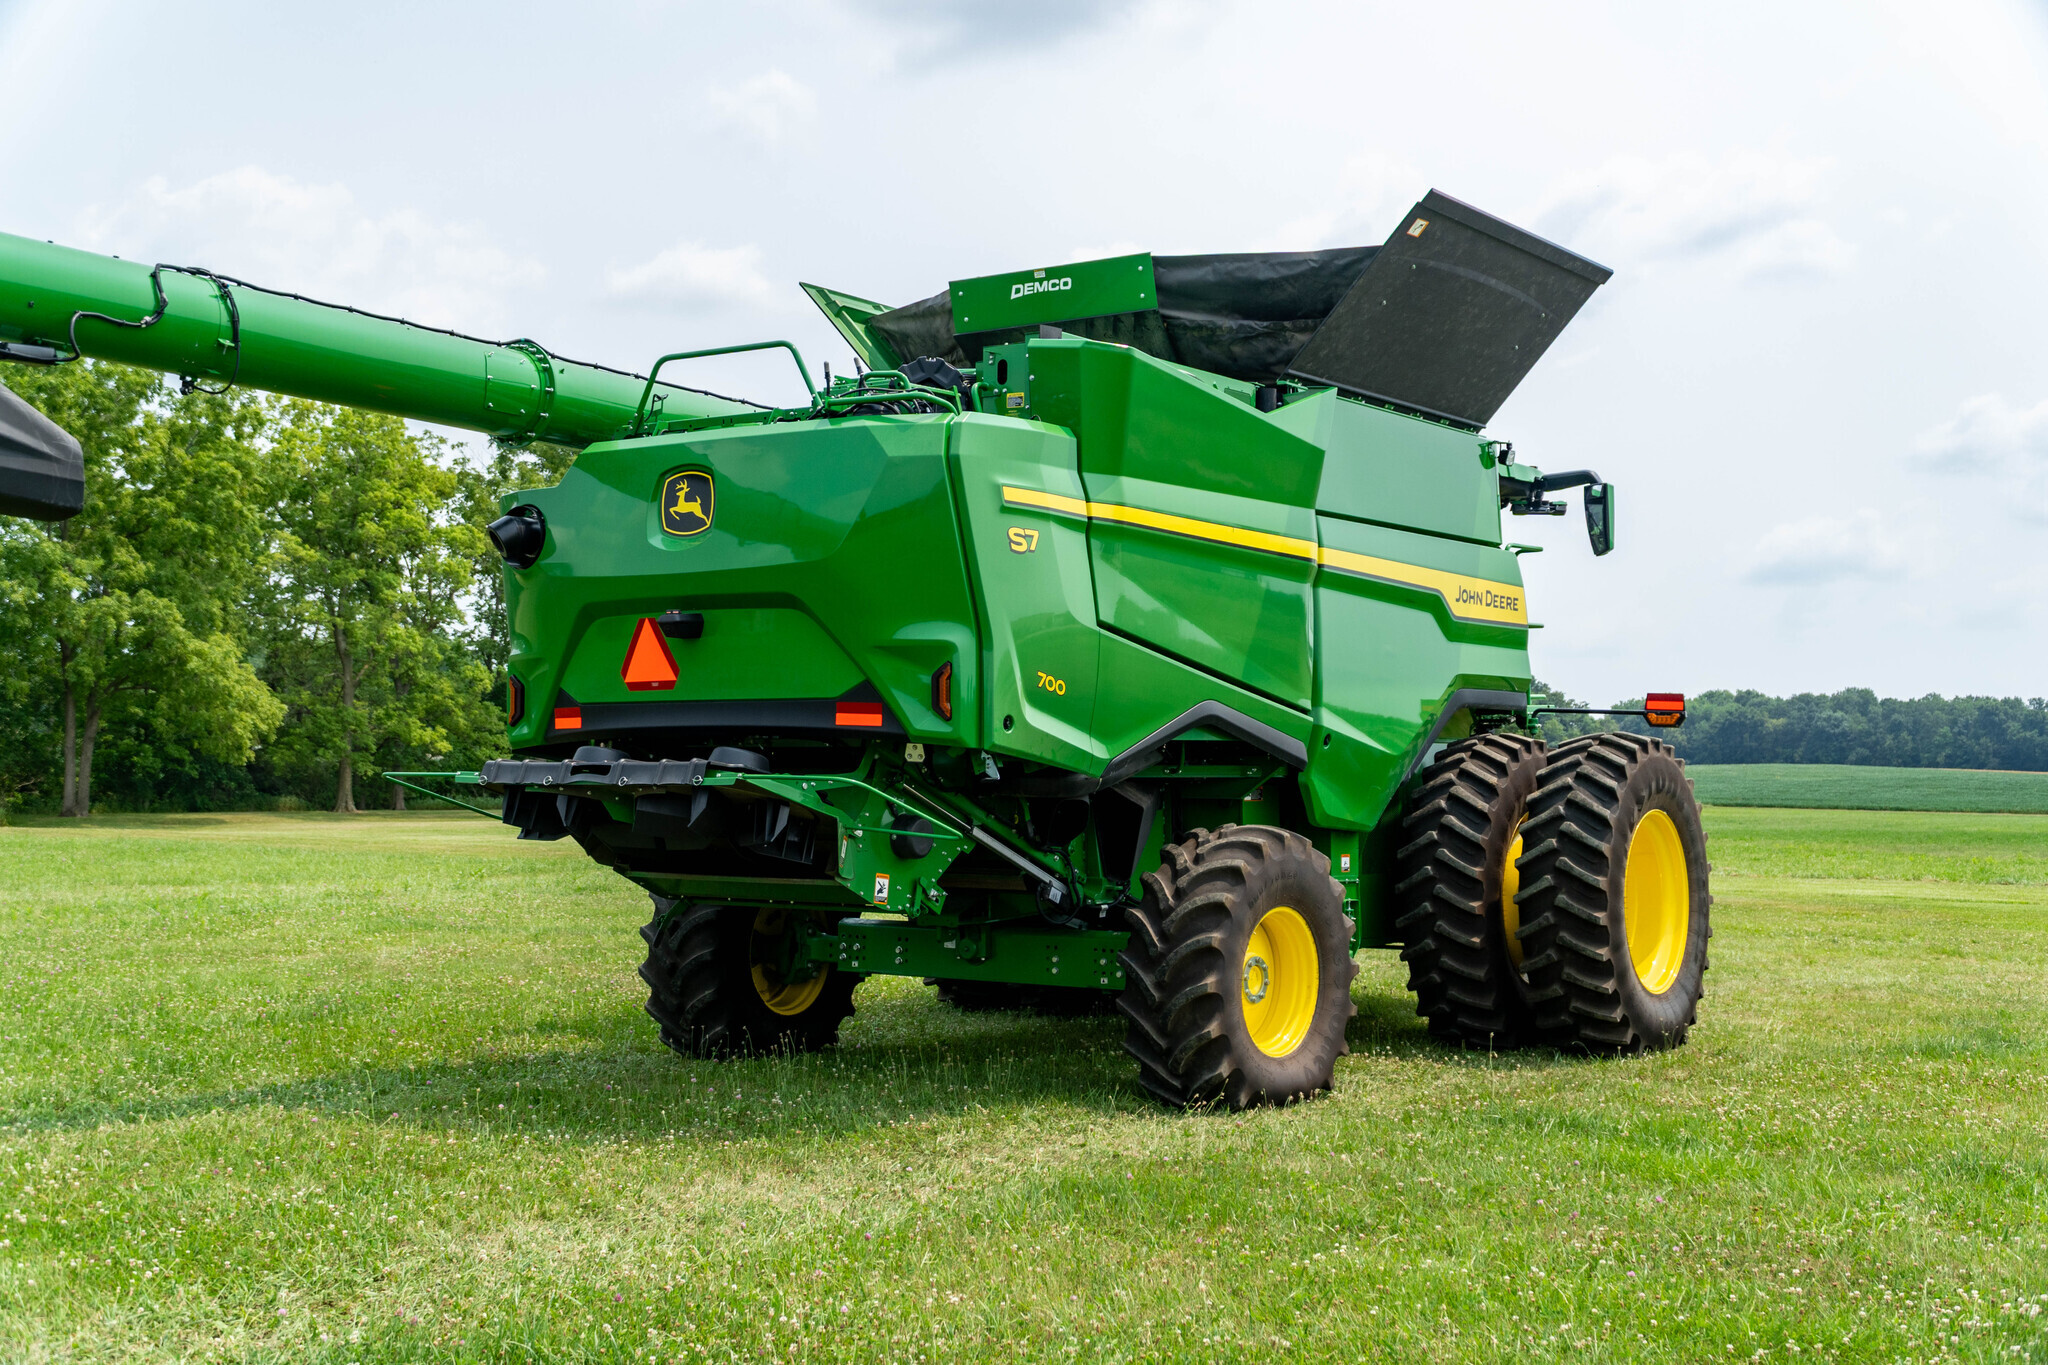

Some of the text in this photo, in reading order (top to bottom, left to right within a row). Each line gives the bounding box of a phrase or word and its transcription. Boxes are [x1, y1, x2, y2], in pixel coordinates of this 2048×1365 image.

[1010, 277, 1072, 300] DEMCO
[1008, 526, 1039, 553] S7
[1455, 585, 1519, 612] JOHN DEERE
[1037, 671, 1066, 696] 700
